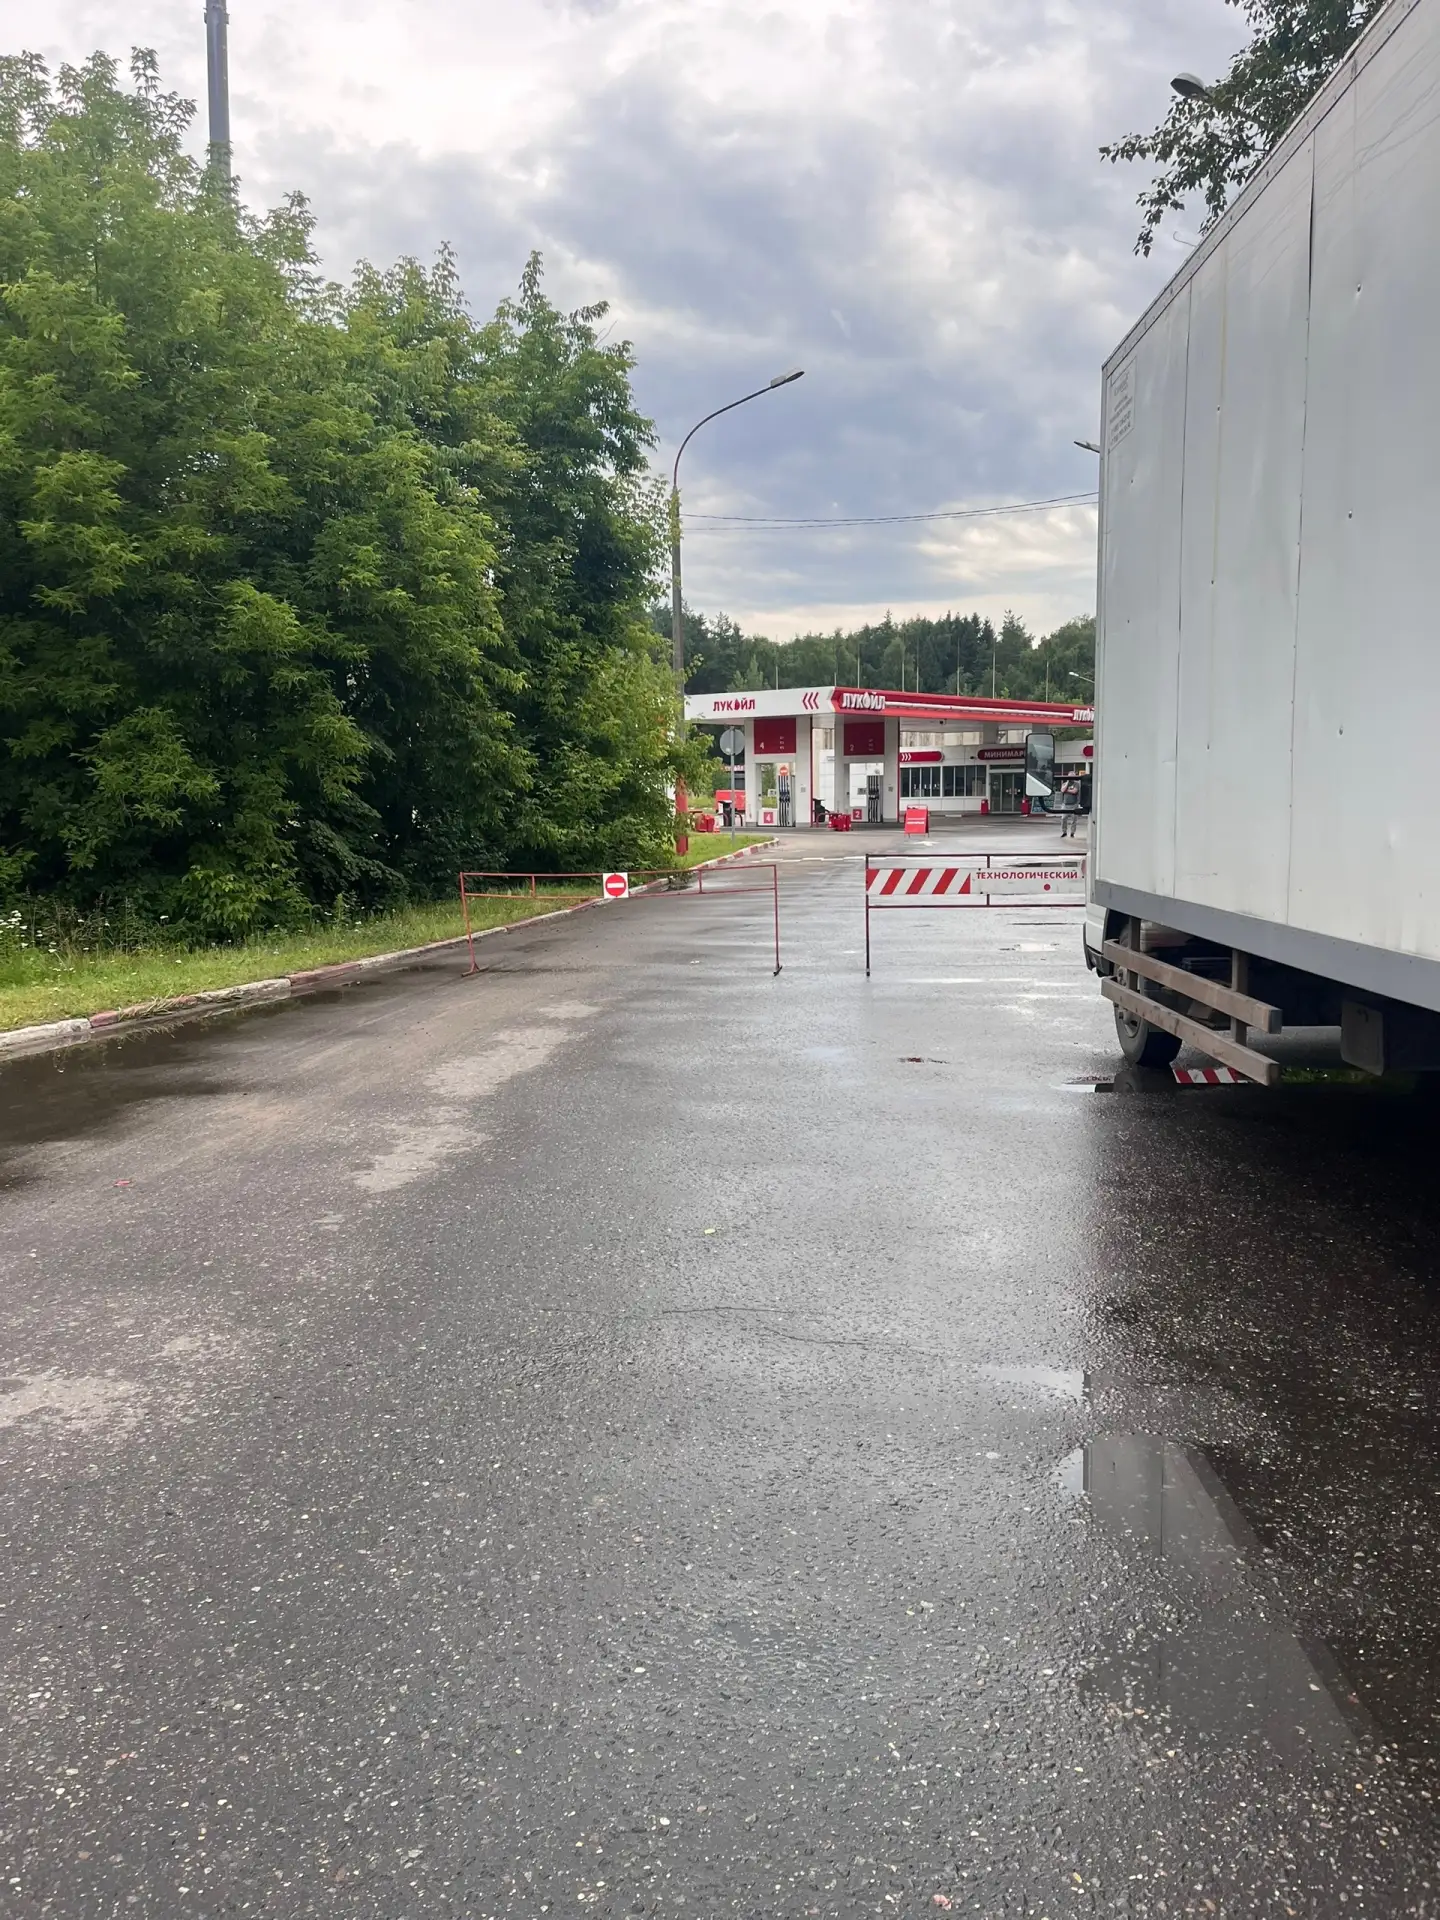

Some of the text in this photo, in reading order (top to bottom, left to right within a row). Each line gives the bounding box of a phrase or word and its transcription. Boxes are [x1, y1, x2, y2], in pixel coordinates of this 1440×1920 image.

[713, 697, 756, 712] ЛУКОЙЛ
[842, 692, 886, 710] ЛУКОЙЛ
[1073, 707, 1095, 722] ЛУКОЙ
[984, 750, 1025, 759] МИНИМАР
[976, 870, 1078, 880] ТЕХНОЛОГИЧЕСКИЙ
